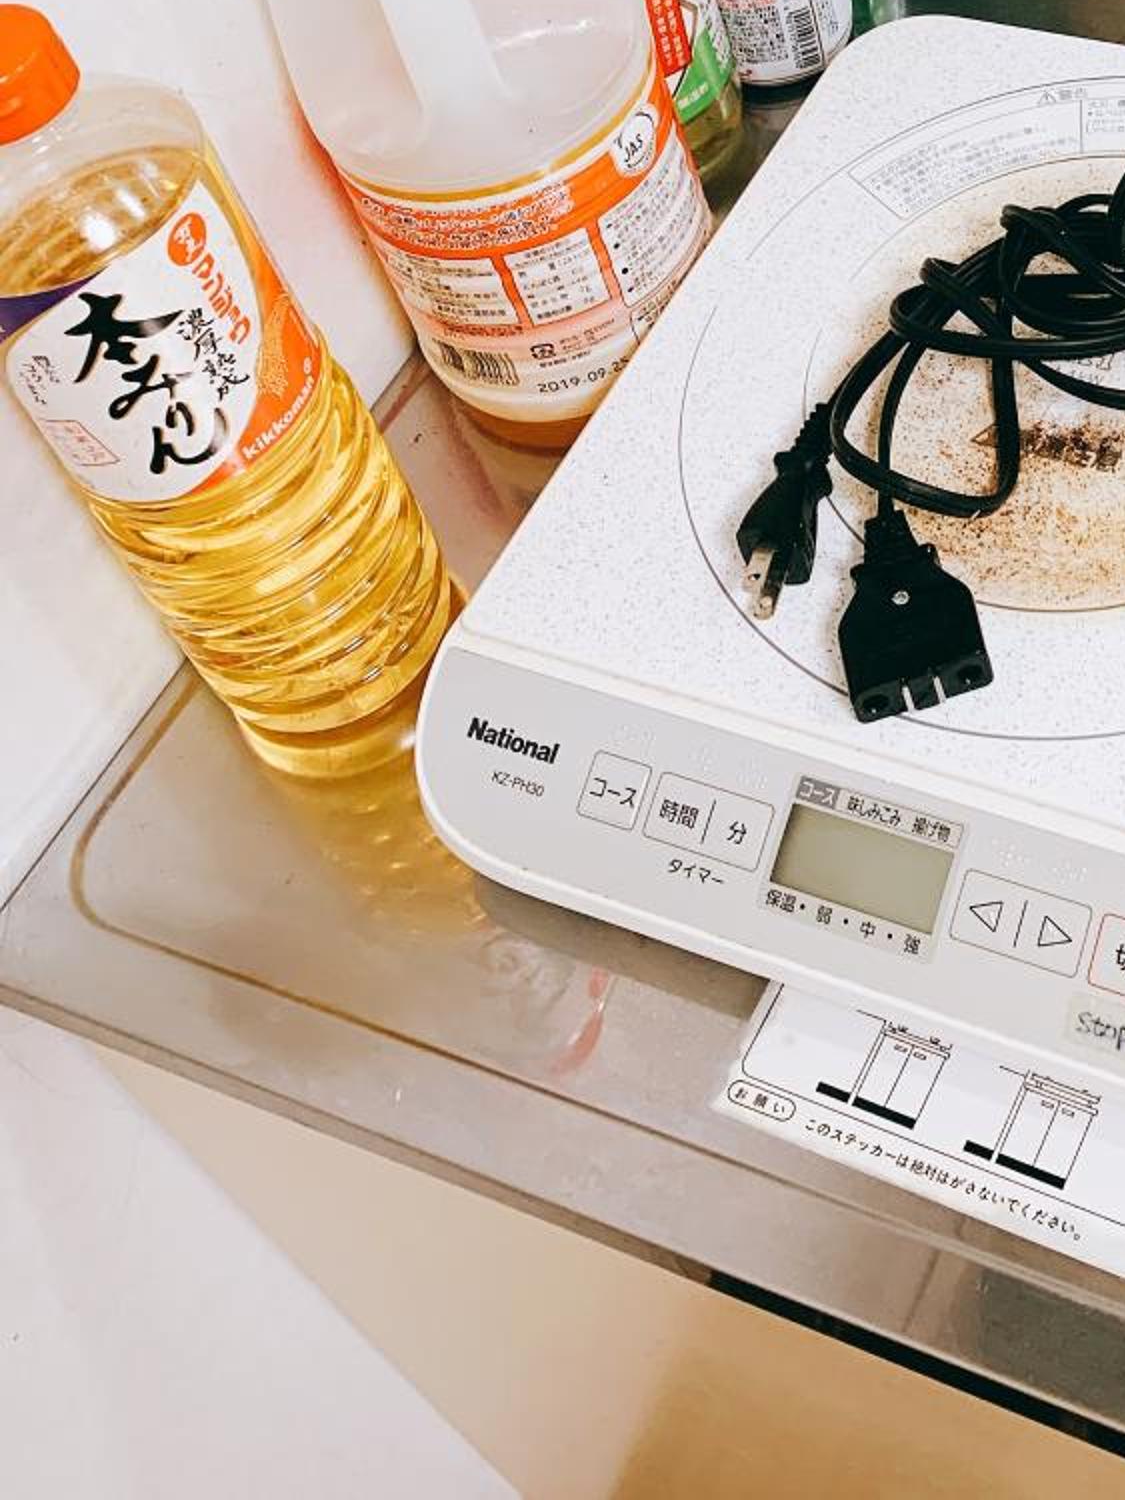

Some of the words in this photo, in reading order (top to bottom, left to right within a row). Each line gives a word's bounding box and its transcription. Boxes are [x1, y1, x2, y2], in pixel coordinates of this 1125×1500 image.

[466, 716, 560, 765] National
[490, 770, 545, 798] KZ-PH30
[588, 776, 638, 809] コース
[799, 779, 837, 805] コース
[658, 798, 700, 830] 時間
[846, 793, 902, 828] 味しみこみ
[911, 813, 952, 844] 揚げ物
[726, 820, 748, 846] 分
[667, 858, 725, 885] タイマー
[735, 1087, 786, 1114] お願い
